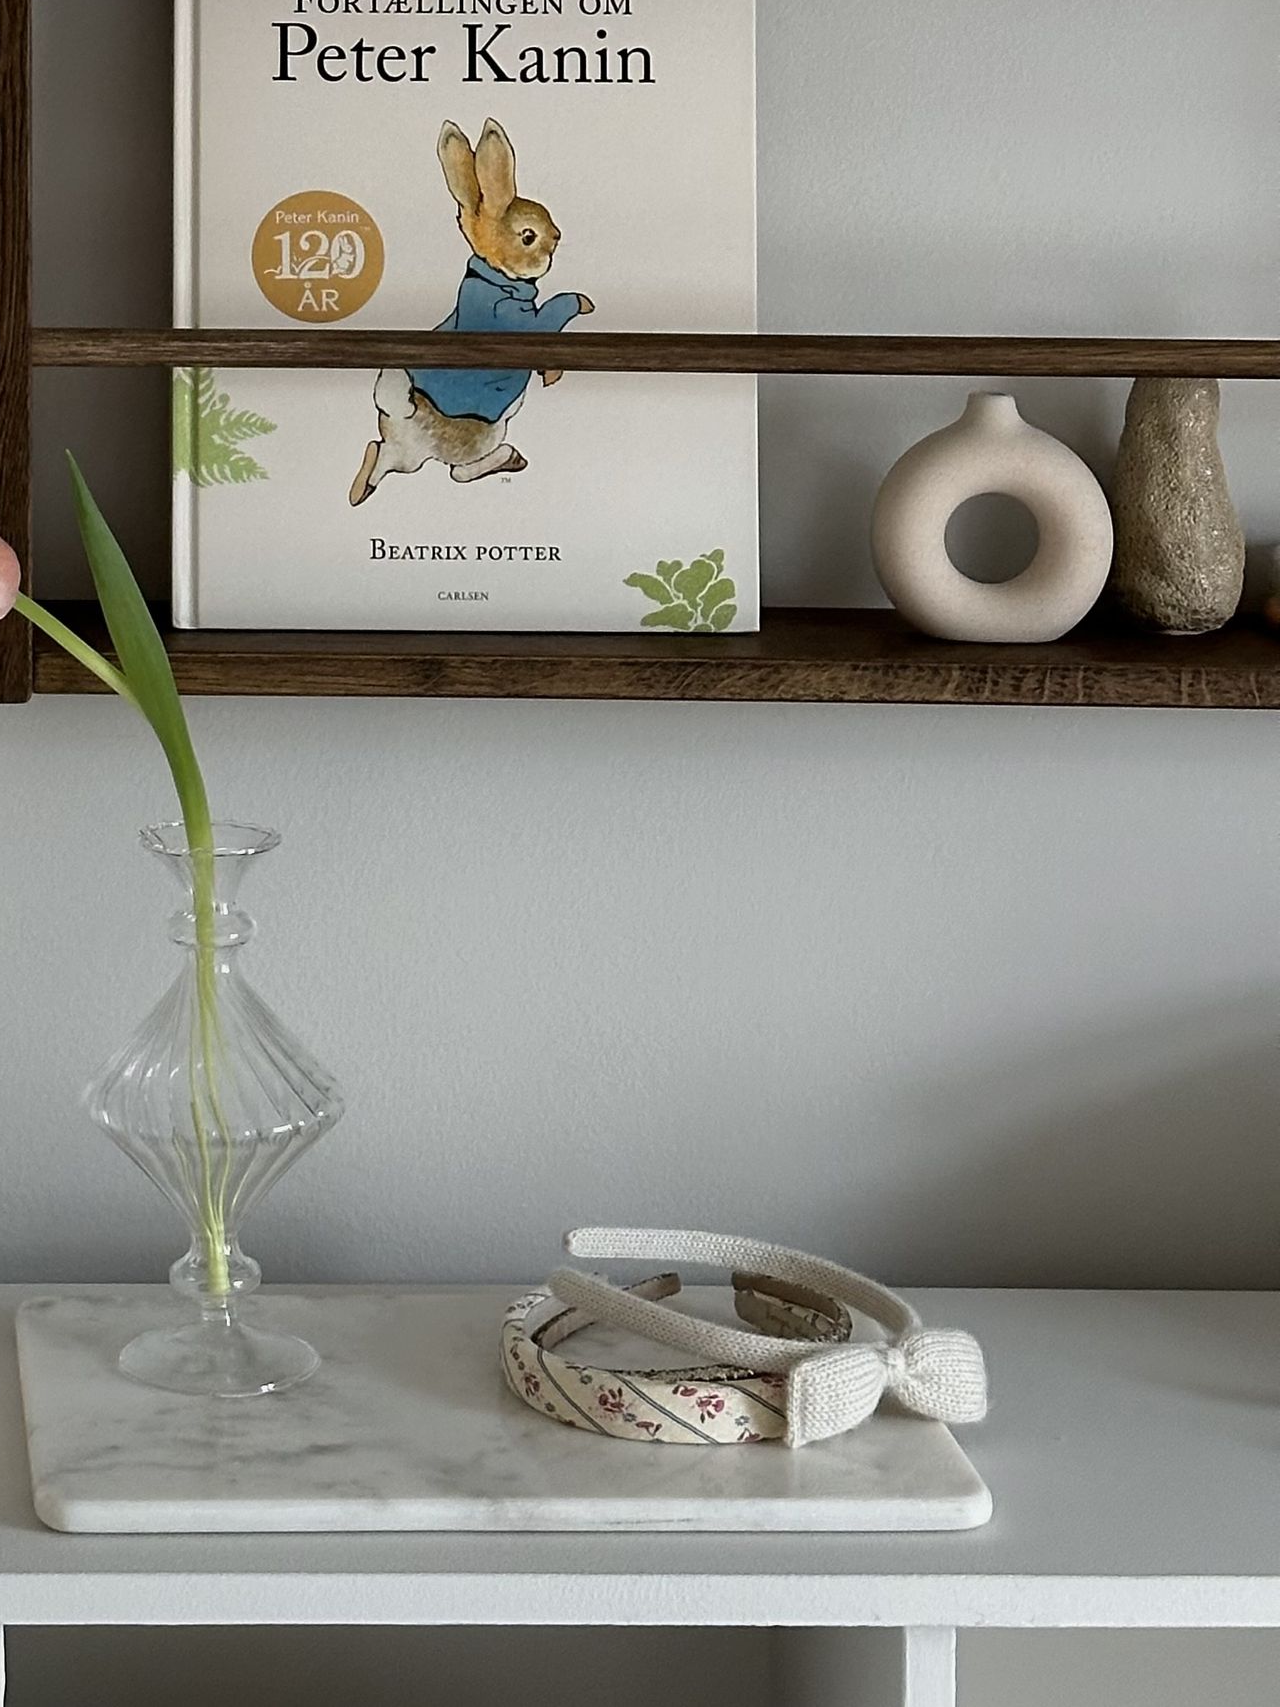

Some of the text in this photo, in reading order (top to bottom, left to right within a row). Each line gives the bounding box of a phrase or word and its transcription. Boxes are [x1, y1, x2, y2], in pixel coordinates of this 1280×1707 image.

[271, 22, 656, 84] Peter Kanin
[275, 210, 359, 224] Peter Kanin
[273, 230, 365, 280] 120
[297, 281, 340, 312] ÅR
[370, 538, 562, 561] BEATRIX POTTER
[437, 591, 489, 601] CARLSEN
